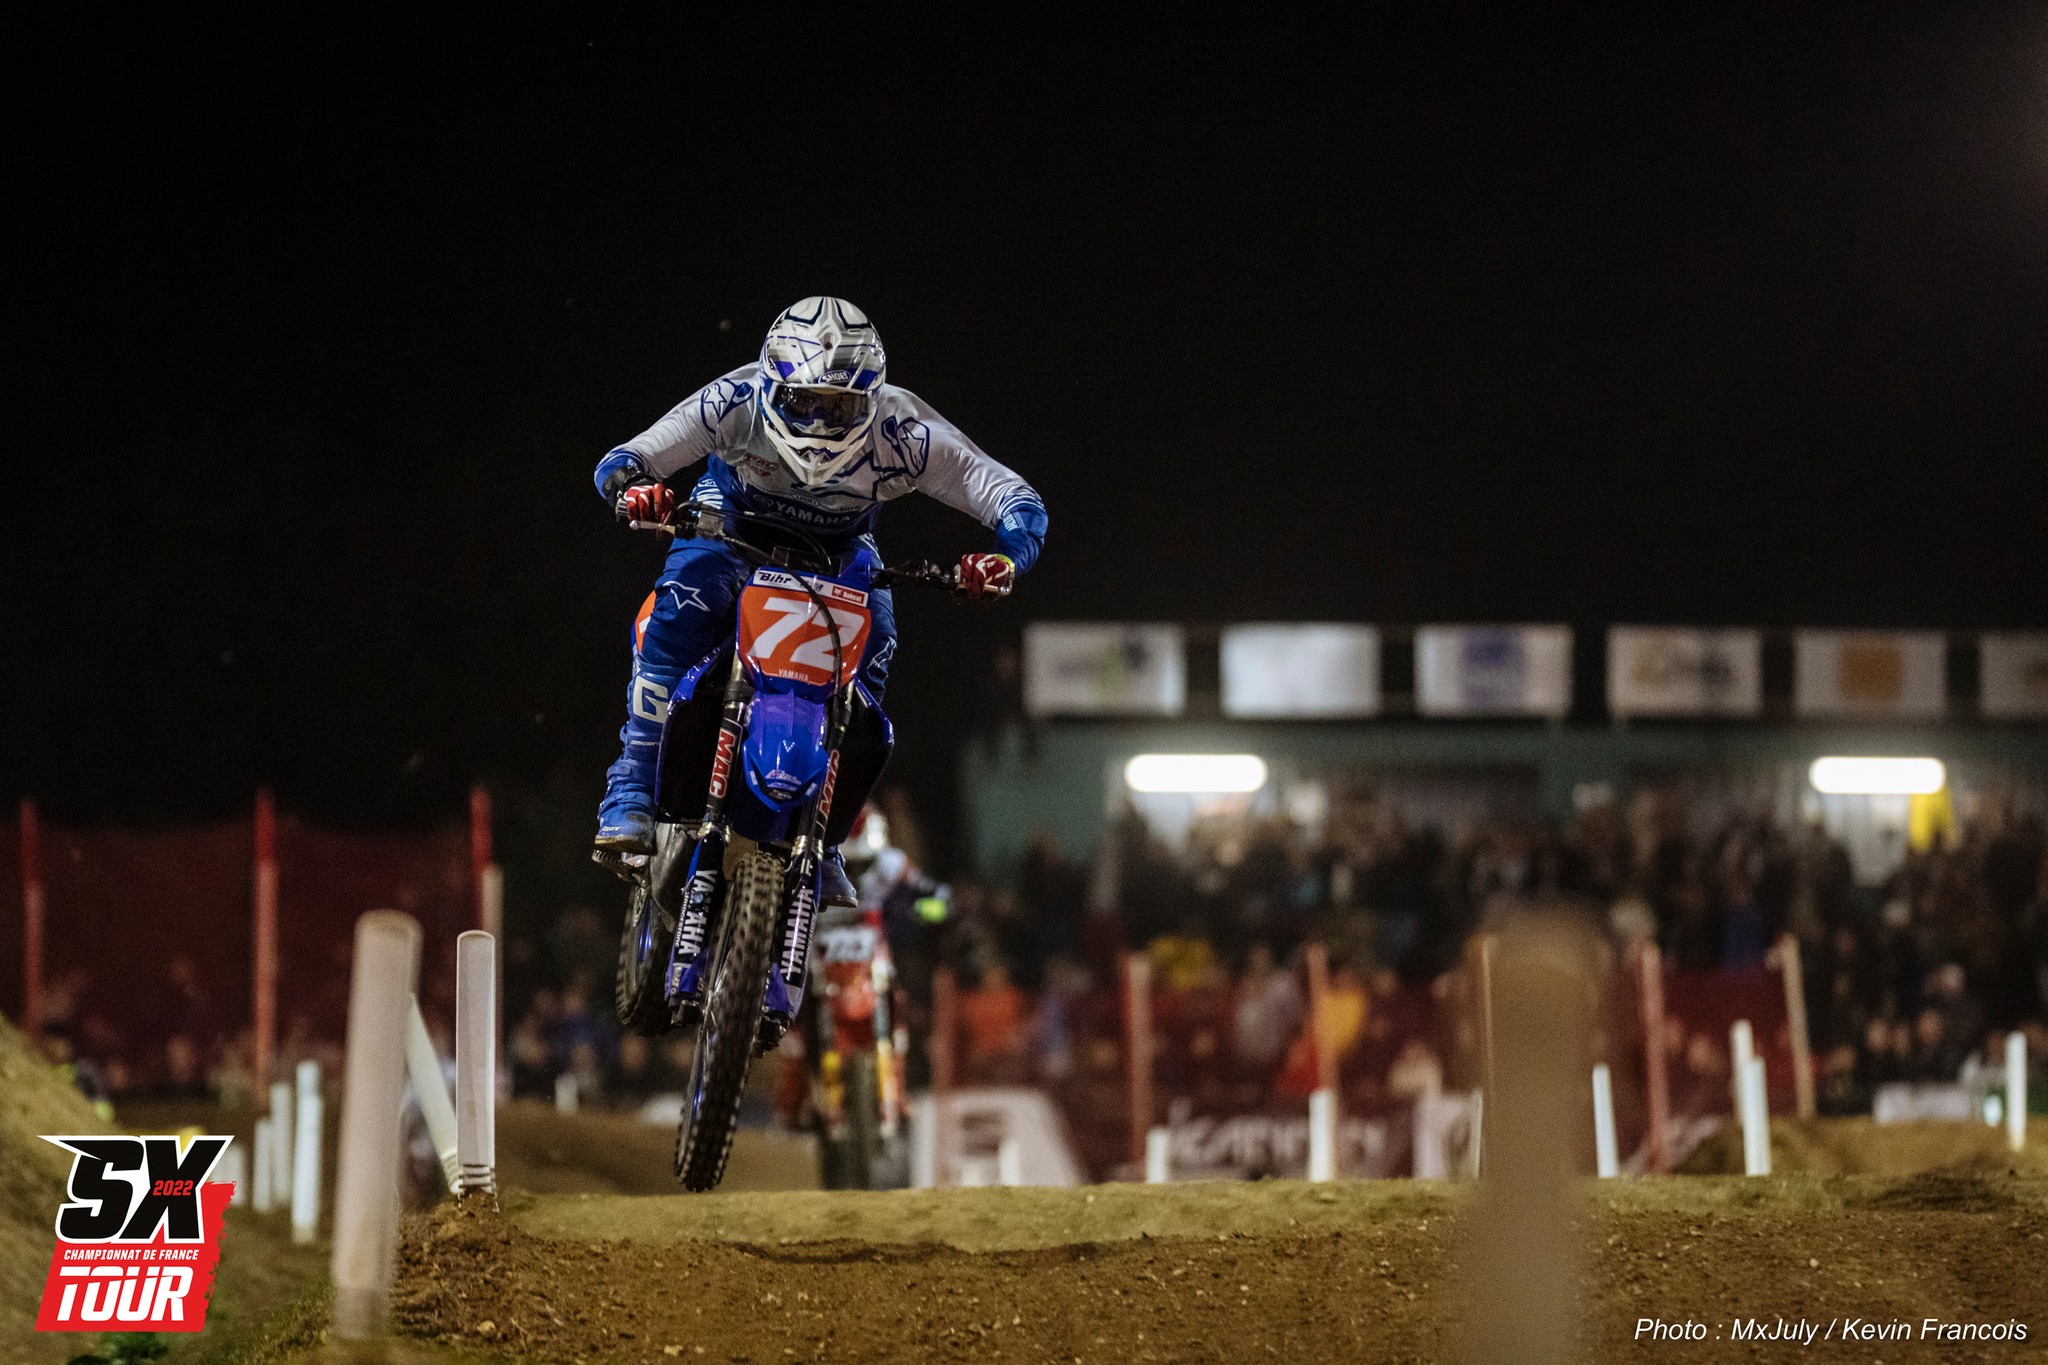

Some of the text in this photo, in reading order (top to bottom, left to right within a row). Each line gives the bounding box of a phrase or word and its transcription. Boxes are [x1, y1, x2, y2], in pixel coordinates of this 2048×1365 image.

[822, 371, 848, 382] SHOEI
[758, 571, 792, 584] Bihr
[746, 596, 865, 673] 72
[778, 668, 809, 682] YAMAHA
[709, 727, 736, 798] MAC
[678, 869, 718, 955] YAAHA
[780, 888, 814, 974] YAMAHA
